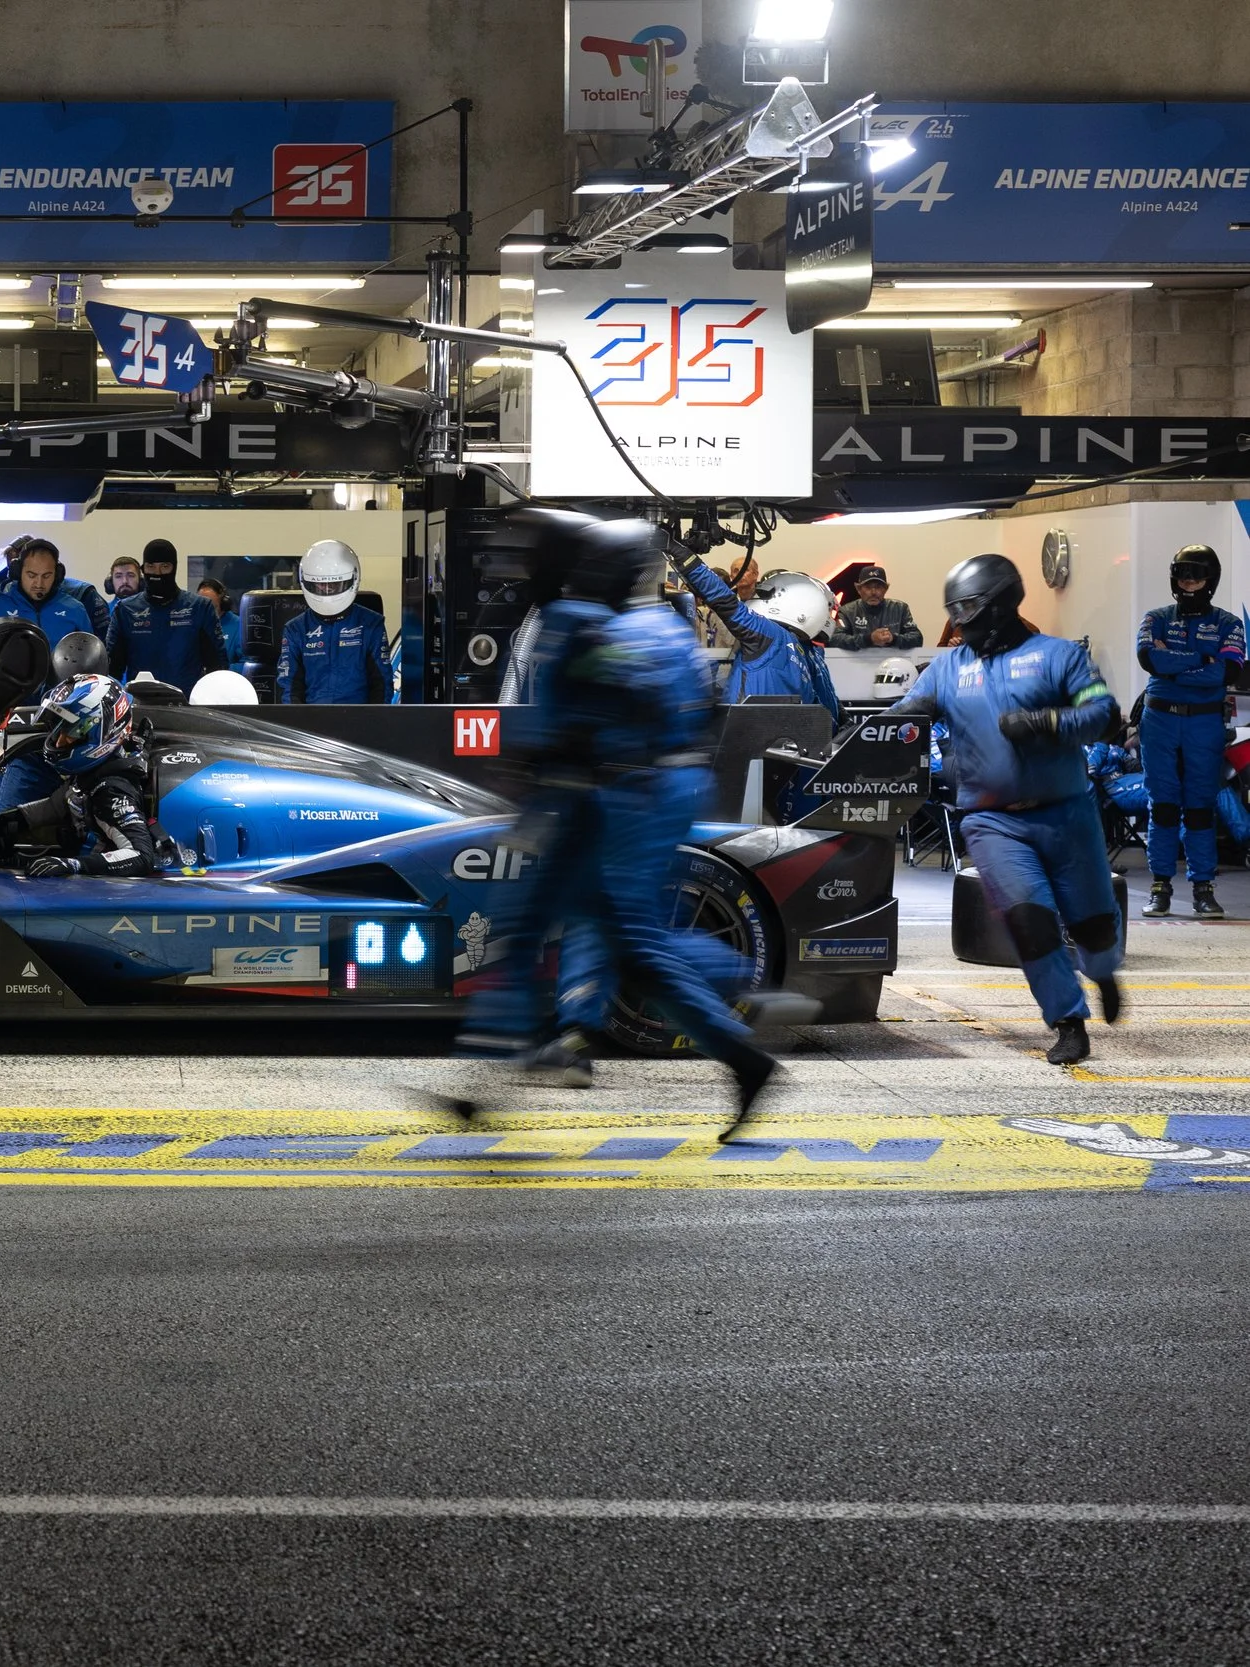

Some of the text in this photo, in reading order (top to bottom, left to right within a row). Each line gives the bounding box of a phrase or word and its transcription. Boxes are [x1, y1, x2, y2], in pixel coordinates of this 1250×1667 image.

[160, 167, 234, 188] TEAM
[286, 165, 354, 206] 35
[994, 168, 1250, 189] ALPINE ENDURANCE
[28, 200, 106, 214] Alpine A424
[793, 181, 864, 241] ALPINE
[1121, 200, 1199, 214] Alpine A424
[118, 312, 168, 386] 35
[584, 297, 768, 407] 35
[611, 436, 741, 450] ALPINE
[819, 425, 1209, 464] ALPINE
[456, 717, 497, 748] HY
[861, 724, 898, 742] elf
[813, 782, 918, 794] EURODATACAR
[842, 799, 890, 823] ixell
[107, 914, 321, 935] ALPINE
[233, 947, 299, 964] WEC
[824, 945, 886, 955] MICHELIN
[5, 983, 51, 994] DEWESoft
